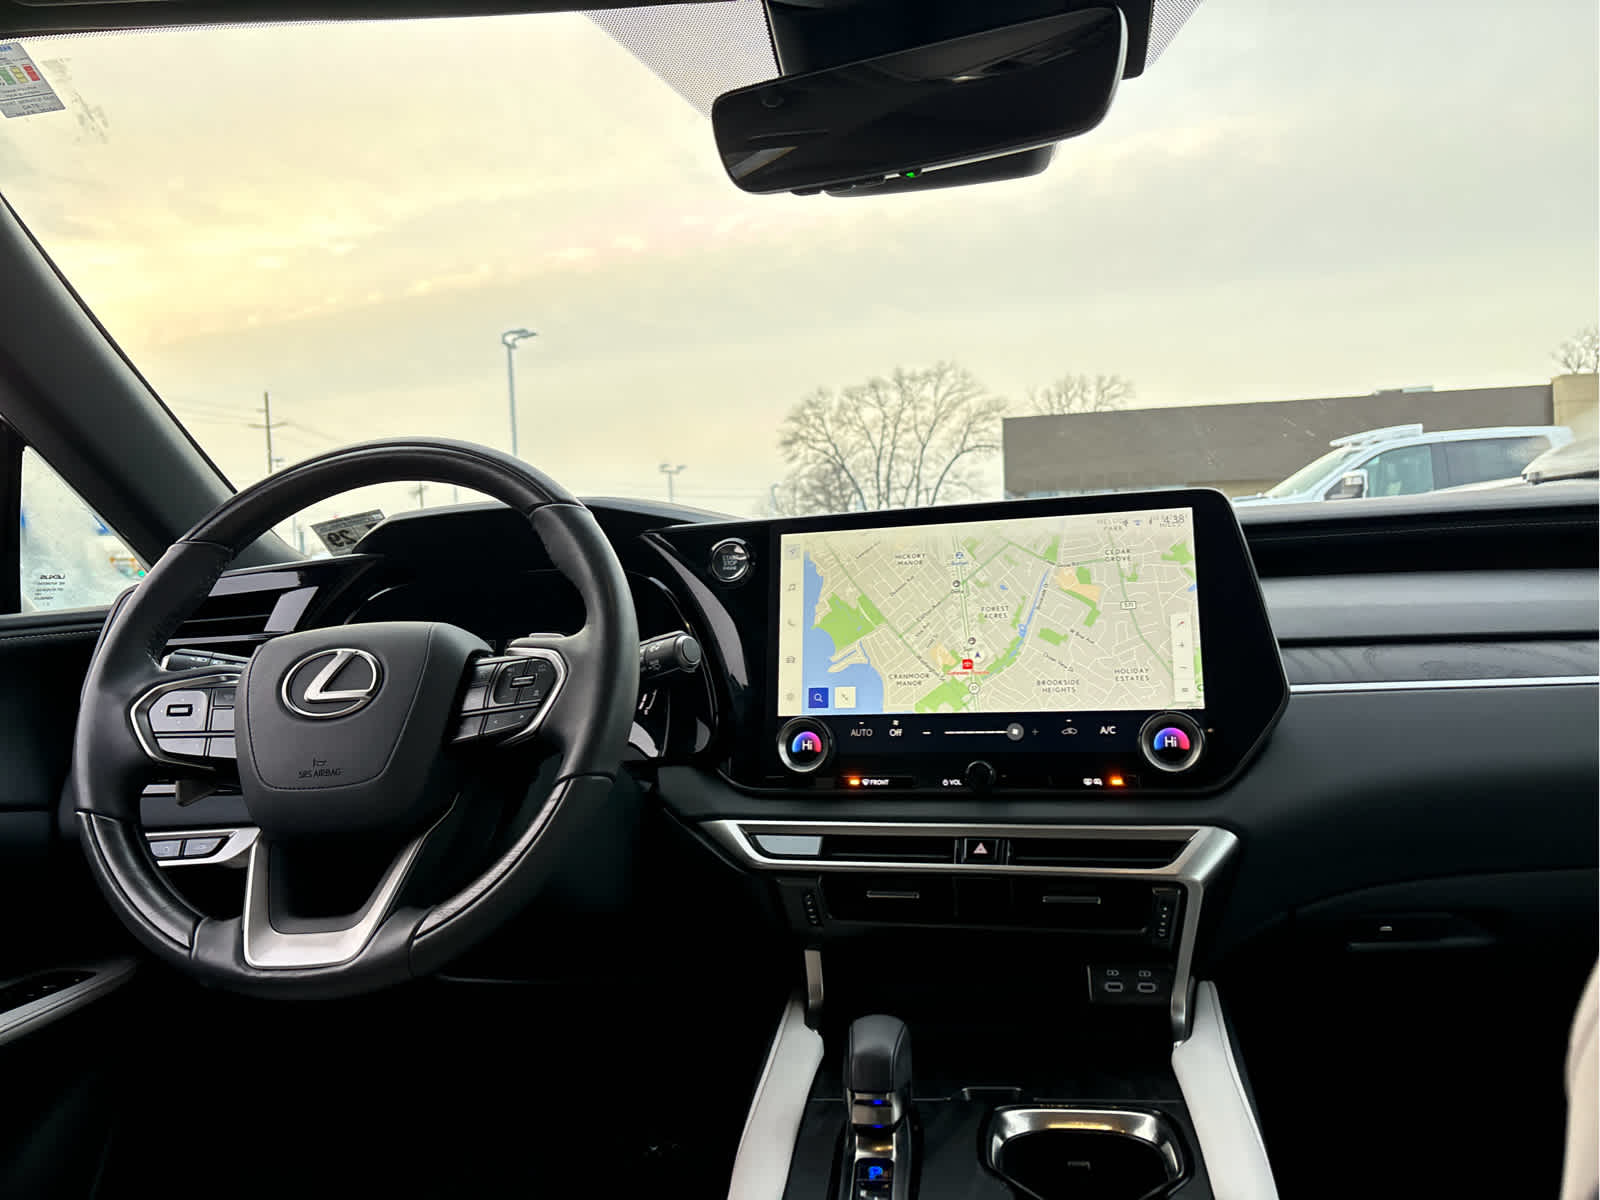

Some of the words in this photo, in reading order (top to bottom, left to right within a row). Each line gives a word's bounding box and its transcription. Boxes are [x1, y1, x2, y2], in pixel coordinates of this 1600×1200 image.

[850, 729, 873, 737] AUTO
[889, 729, 903, 737] Off
[1099, 726, 1117, 735] A/C
[802, 740, 813, 751] Hi
[1164, 736, 1177, 747] Hi
